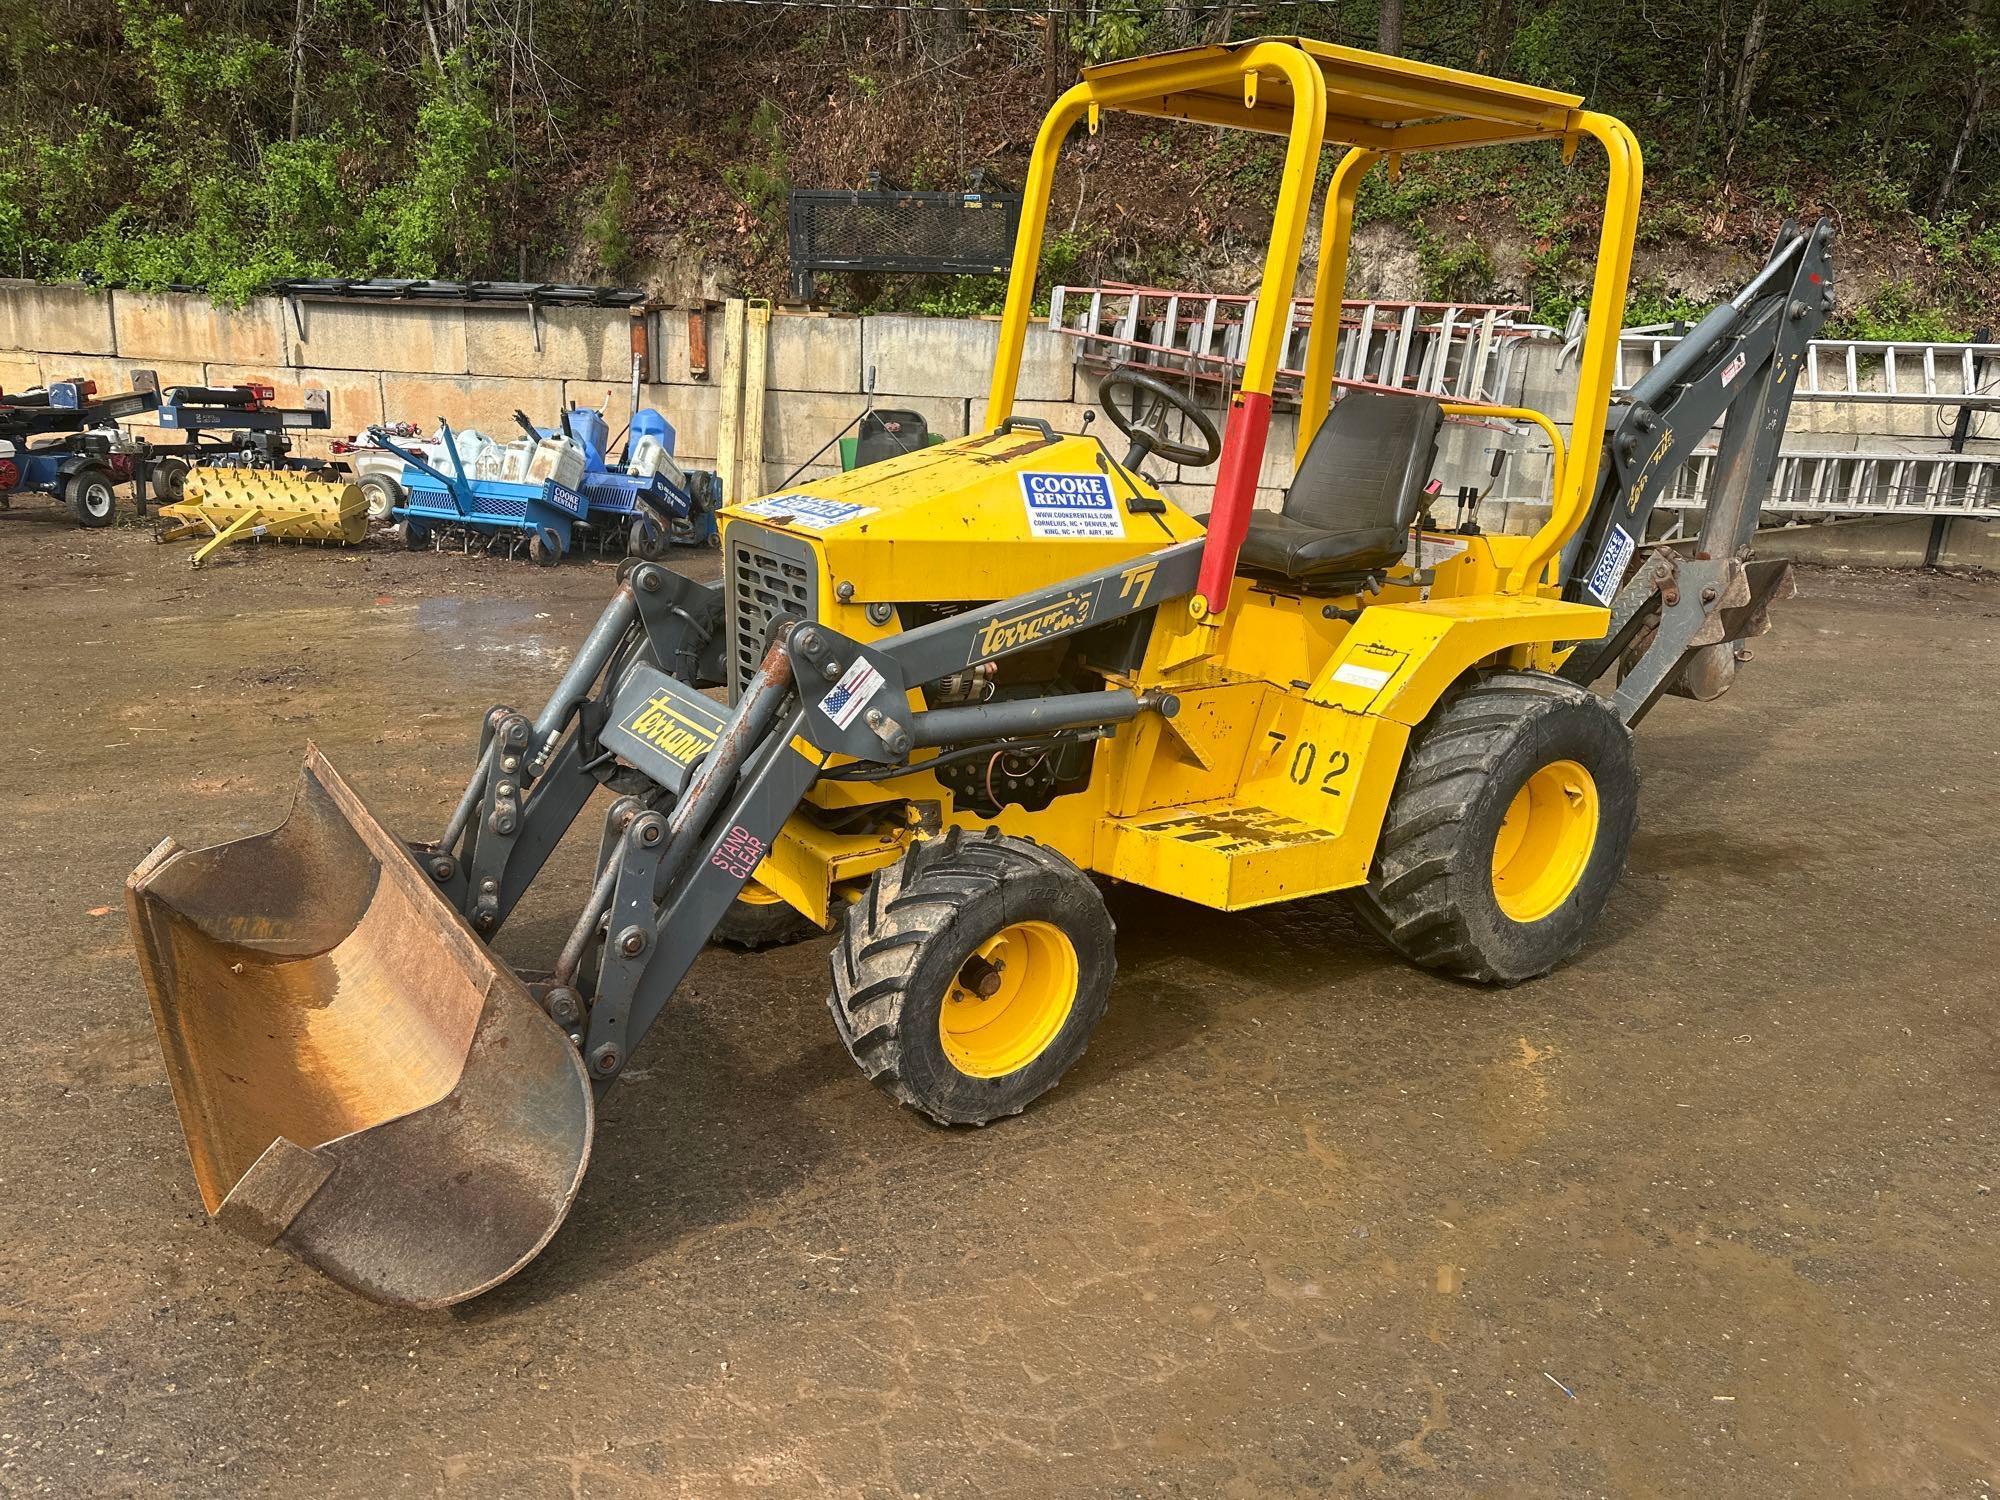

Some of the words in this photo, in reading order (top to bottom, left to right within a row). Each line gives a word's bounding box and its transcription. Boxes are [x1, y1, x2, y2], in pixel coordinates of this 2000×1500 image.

[553, 495, 578, 512] RENTALS
[554, 487, 579, 505] COOKE
[1030, 477, 1104, 493] COOKE
[1033, 492, 1107, 507] RENTALS
[1594, 532, 1620, 586] COOKE
[1597, 537, 1624, 591] RENTALS
[1119, 560, 1160, 609] T7
[1268, 730, 1350, 797] 702
[711, 825, 750, 870] STAND
[728, 836, 763, 879] CLEAR
